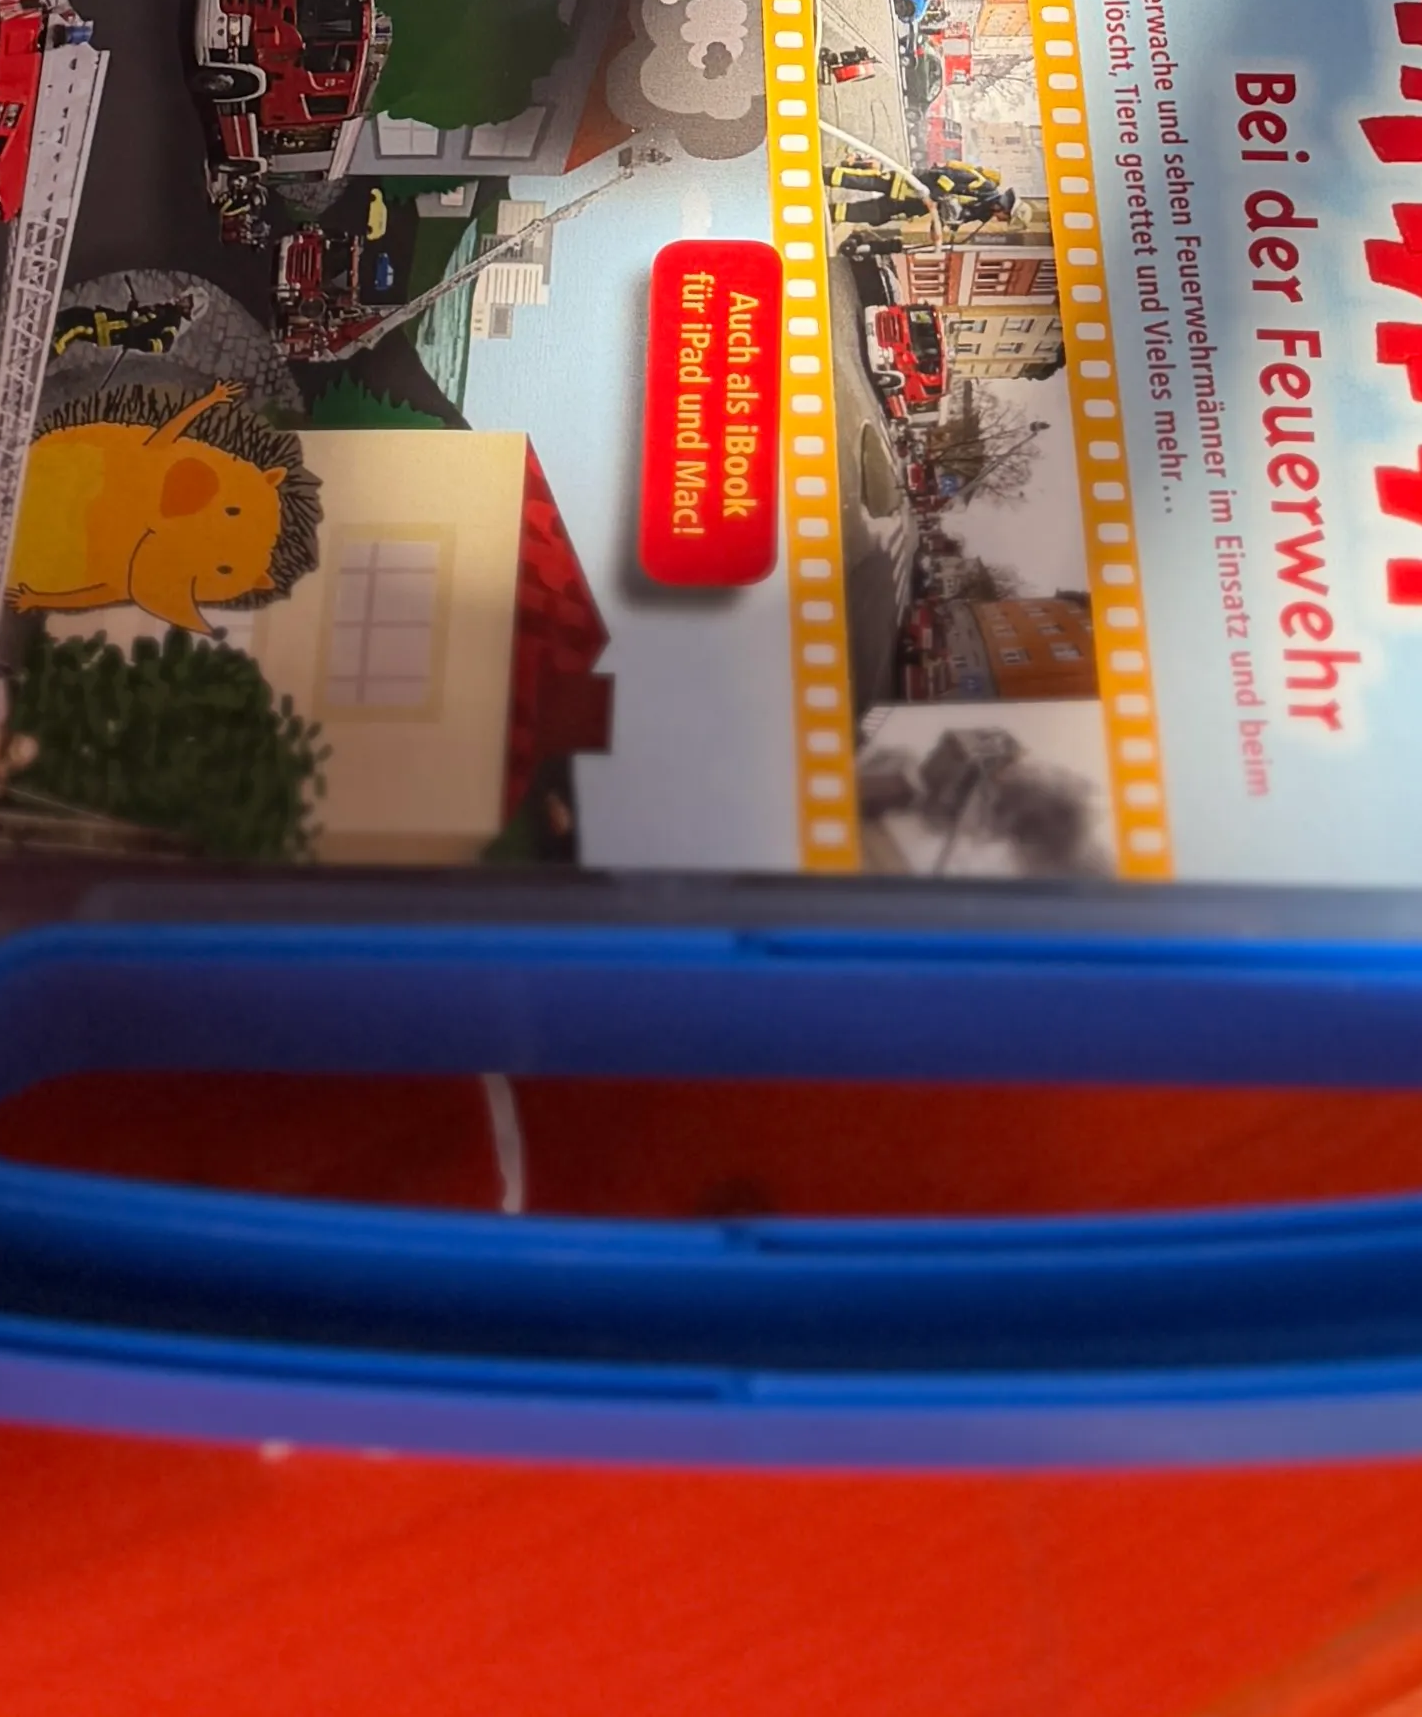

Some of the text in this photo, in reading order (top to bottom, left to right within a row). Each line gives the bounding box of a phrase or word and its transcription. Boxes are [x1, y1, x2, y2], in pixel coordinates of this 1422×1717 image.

[1114, 84, 1142, 144] Tiere
[1156, 100, 1189, 144] und
[1115, 152, 1158, 256] gerettet
[1164, 153, 1195, 226] sehen
[1136, 265, 1169, 313] und
[1143, 320, 1177, 401] Vieles
[1174, 235, 1227, 479] Feuerwehrmänner
[672, 270, 715, 535] für iPad und Mac!
[722, 290, 761, 518] Auch als iBook
[1234, 72, 1362, 732] Bei der Feuerwehr
[1208, 489, 1237, 523] im
[1214, 535, 1252, 639] Einsatz
[1229, 650, 1266, 707] und
[1238, 719, 1272, 798] beim
